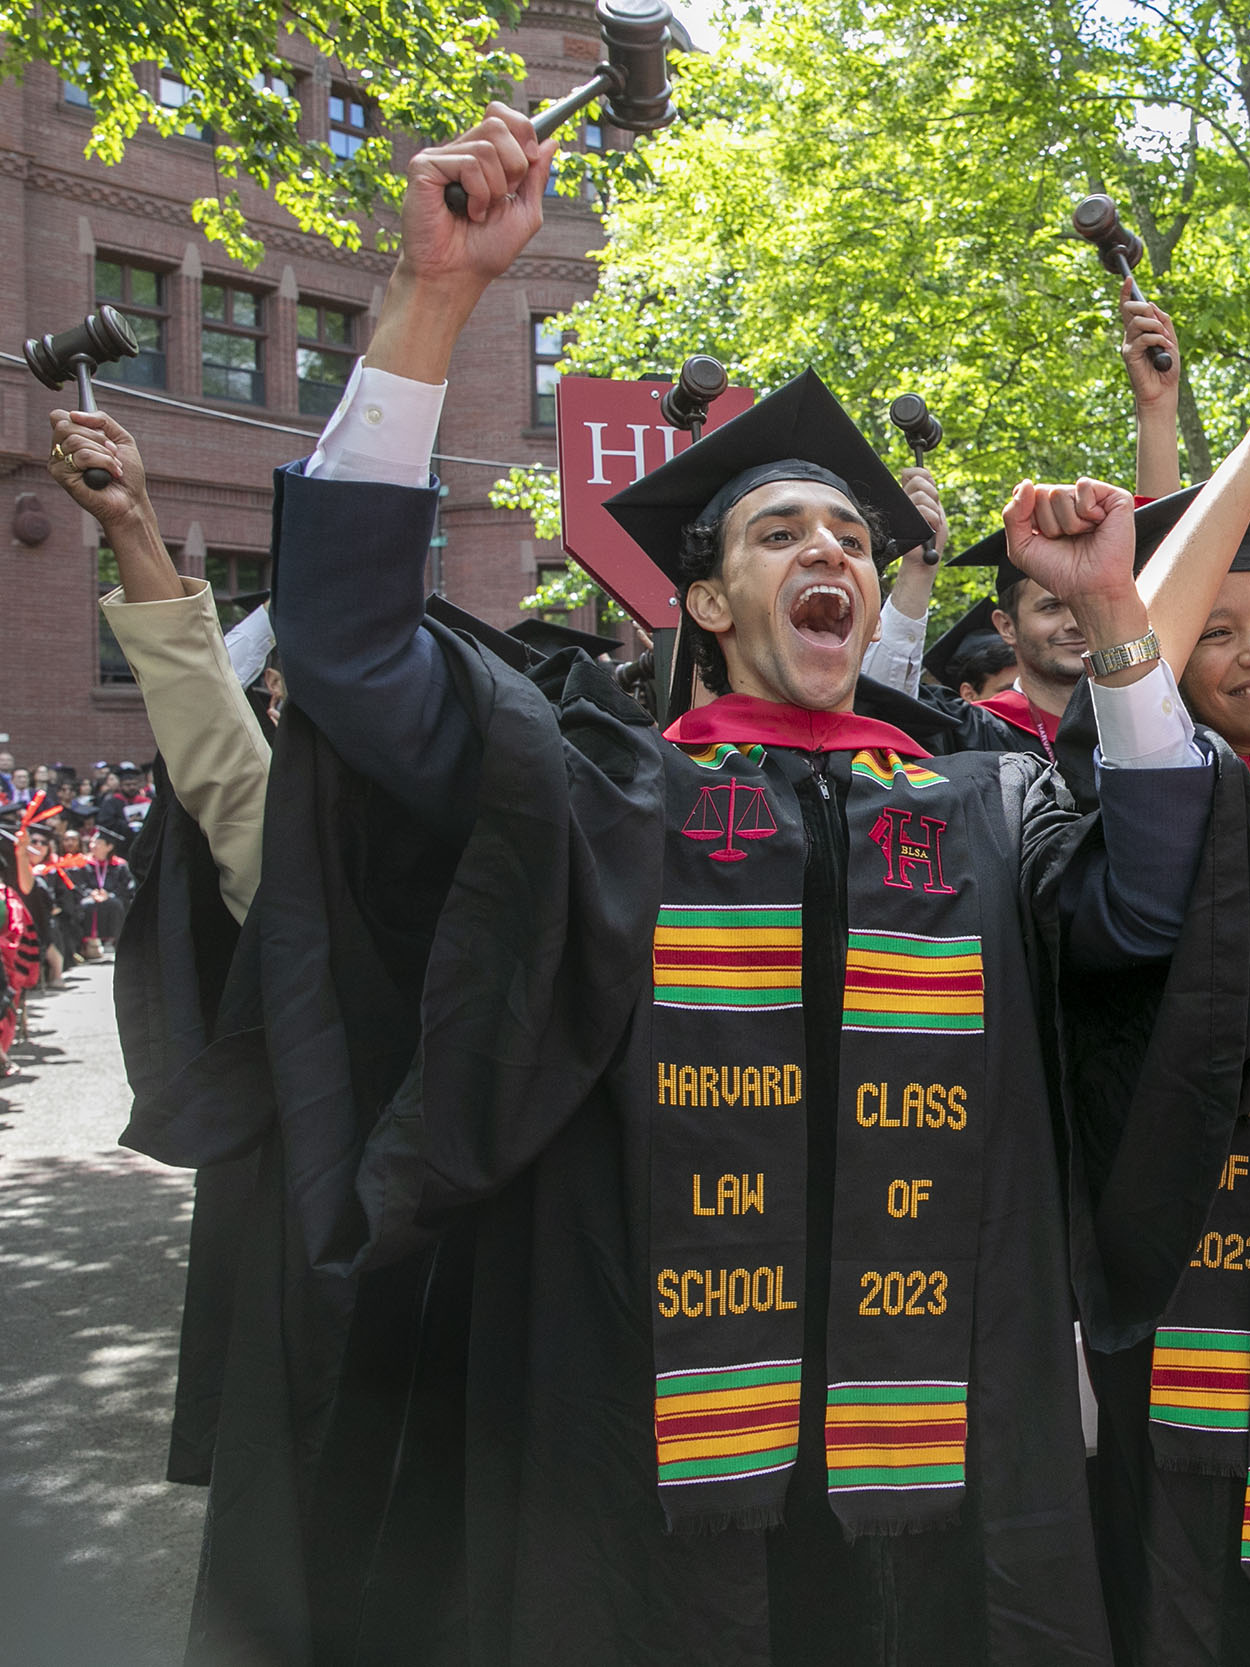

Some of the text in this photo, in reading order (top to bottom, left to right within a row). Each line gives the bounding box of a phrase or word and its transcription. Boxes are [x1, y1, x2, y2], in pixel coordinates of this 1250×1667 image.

[900, 845, 928, 859] BLSA
[657, 1062, 802, 1107] HARVARD
[856, 1082, 967, 1130] CLASS
[693, 1173, 764, 1216] LAW
[887, 1179, 933, 1218] OF
[657, 1266, 797, 1318] SCHOOL
[858, 1270, 948, 1316] 2023
